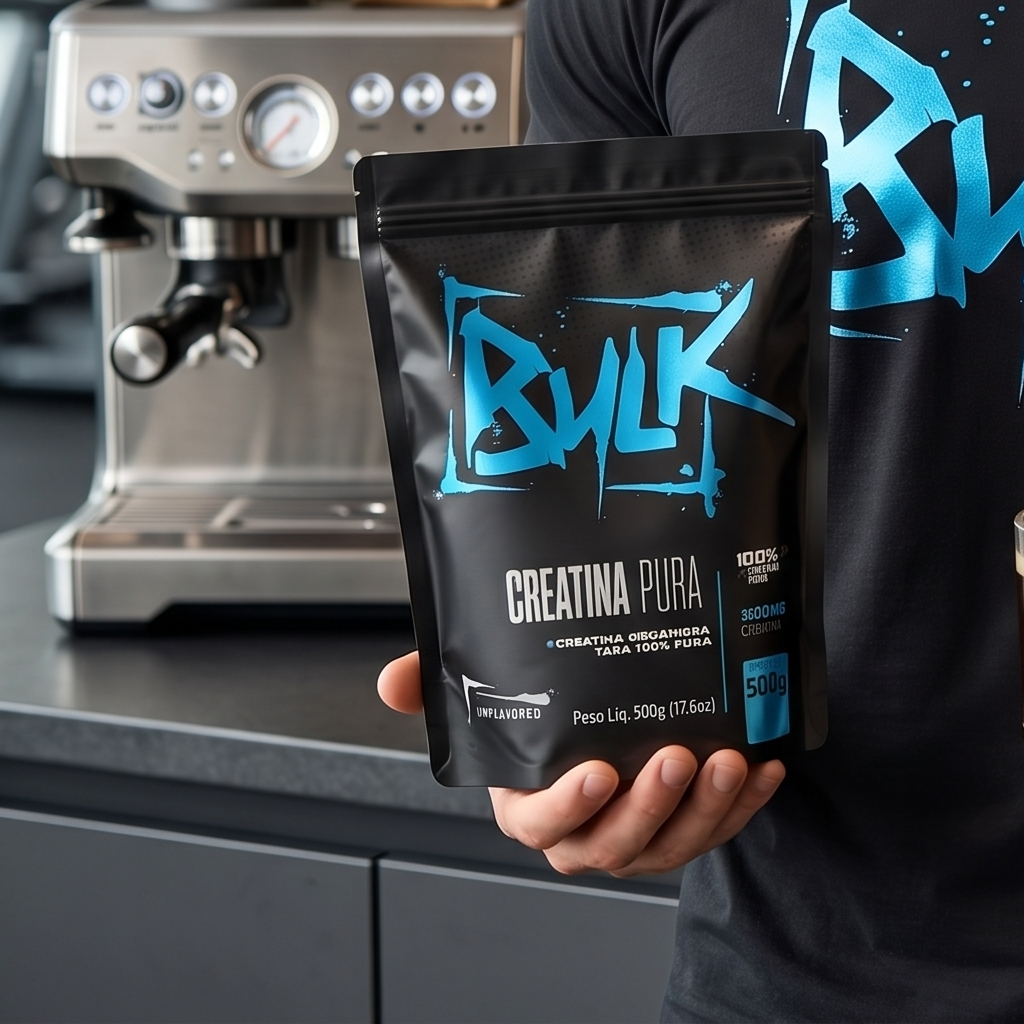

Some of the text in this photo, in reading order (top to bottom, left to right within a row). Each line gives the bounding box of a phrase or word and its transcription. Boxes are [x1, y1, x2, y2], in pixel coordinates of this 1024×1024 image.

[459, 277, 796, 521] BULK
[736, 547, 779, 567] 100%
[505, 555, 702, 624] CREATINA PURA
[741, 601, 786, 622] 3600MG
[555, 633, 624, 649] CREATINA
[594, 645, 632, 657] TARA
[635, 640, 671, 654] 100%
[746, 671, 787, 699] 500g
[573, 709, 604, 725] Peso
[633, 703, 666, 721] 500g
[669, 696, 716, 719] (17.6oz)
